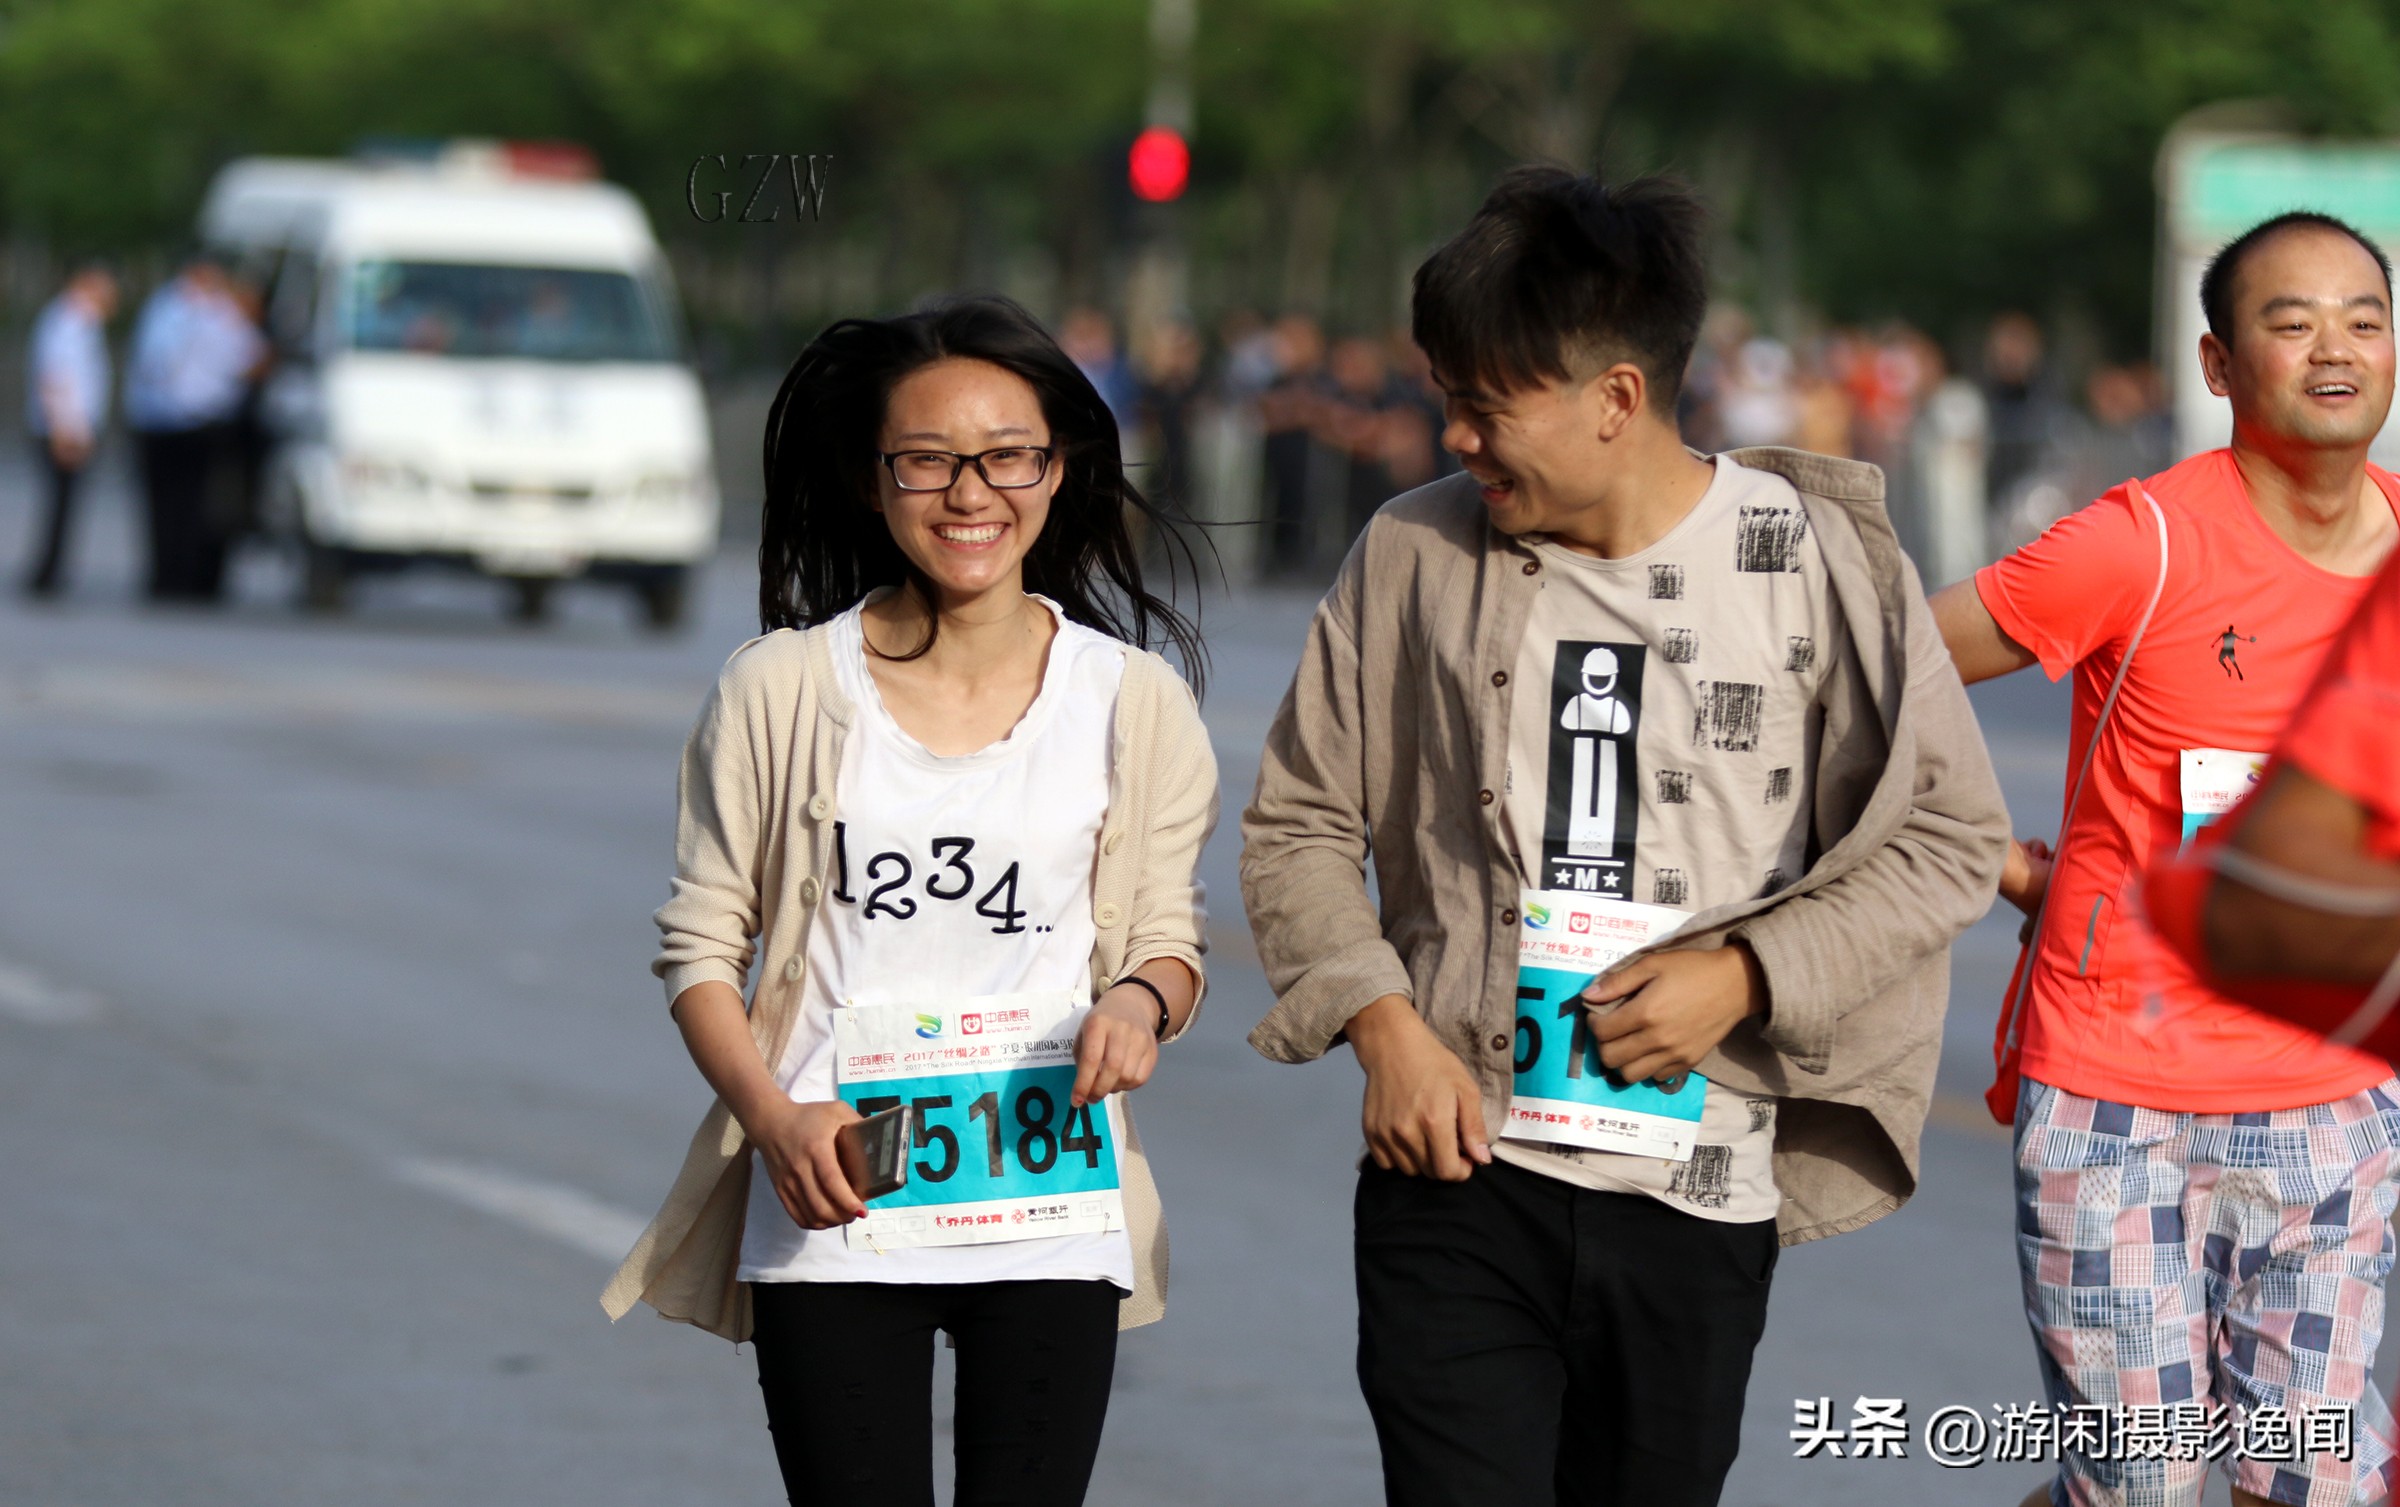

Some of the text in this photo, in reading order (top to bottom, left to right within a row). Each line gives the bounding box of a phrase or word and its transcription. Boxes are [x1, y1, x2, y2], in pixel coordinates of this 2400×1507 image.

[1574, 868, 1597, 891] M
[984, 1009, 1031, 1023] 中商惠民
[848, 1052, 896, 1067] 中商惠民
[941, 1060, 954, 1068] Silk
